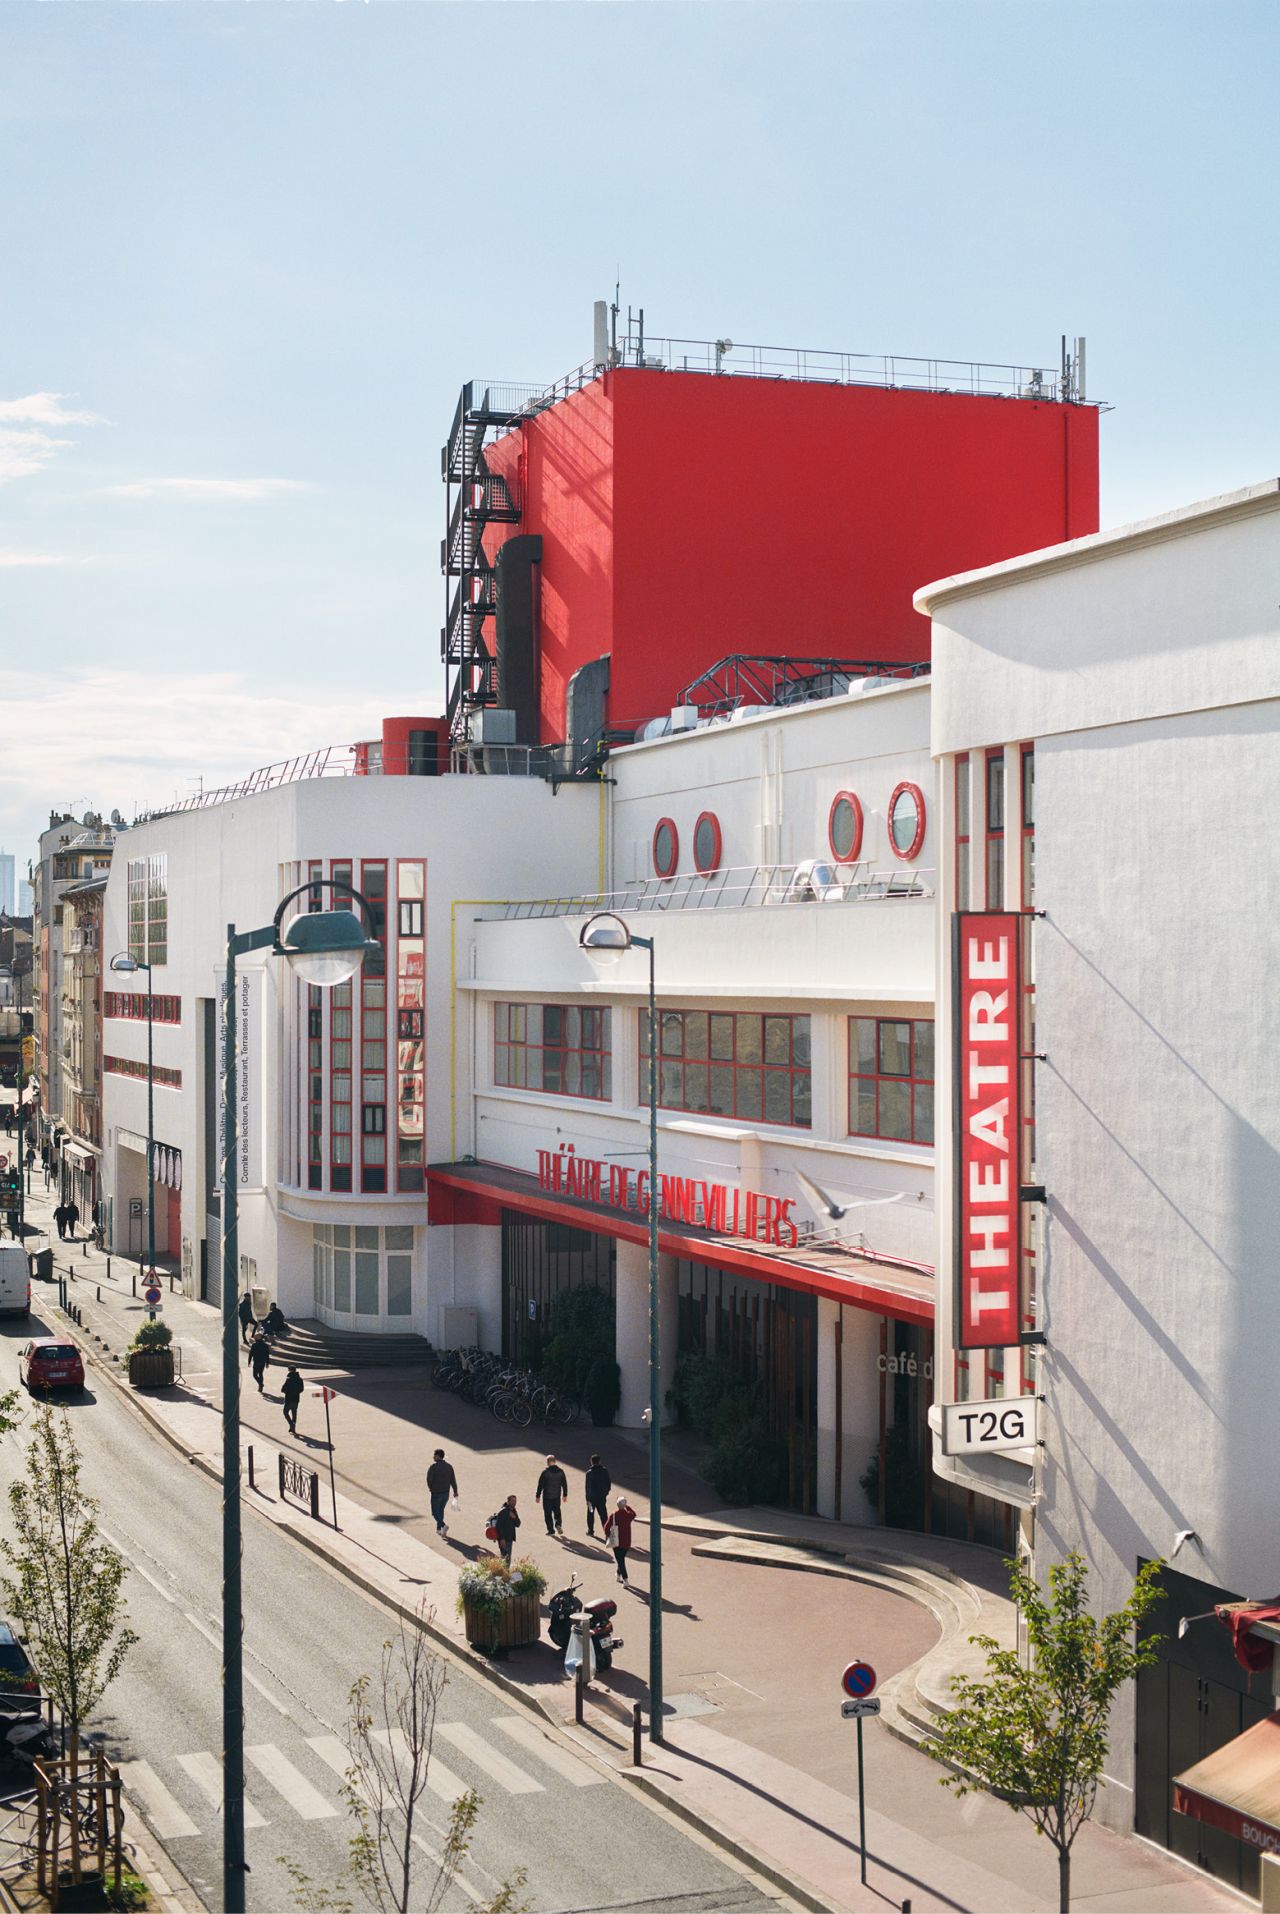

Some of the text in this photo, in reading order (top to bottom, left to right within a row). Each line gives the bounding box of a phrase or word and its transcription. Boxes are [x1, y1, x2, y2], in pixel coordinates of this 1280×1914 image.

[241, 975, 250, 1007] potager
[241, 1008, 248, 1017] et
[241, 1103, 249, 1137] lecteurs,
[968, 935, 1010, 1328] THEATRE
[535, 1143, 609, 1204] THÉÂTRE
[609, 1164, 635, 1212] DE
[876, 1351, 917, 1378] café
[958, 1409, 1025, 1444] T2G
